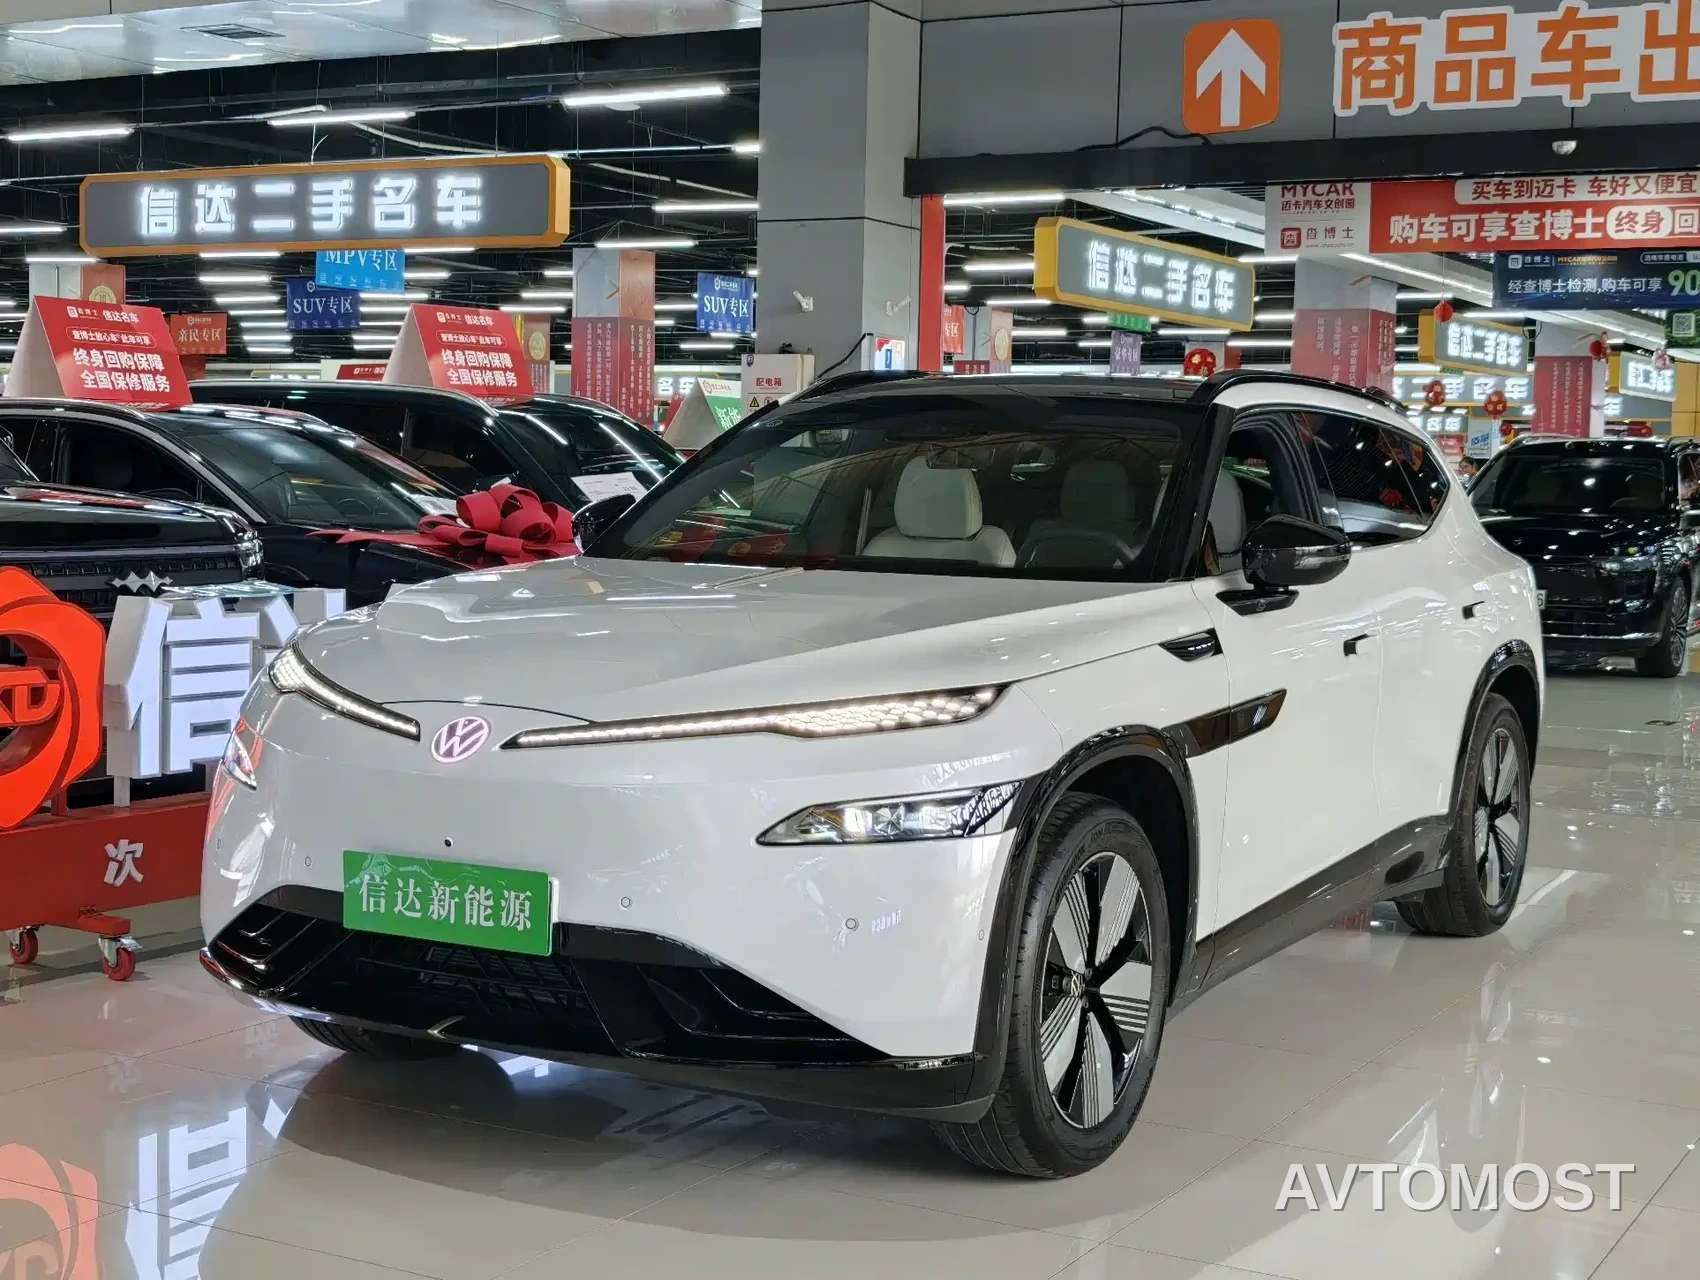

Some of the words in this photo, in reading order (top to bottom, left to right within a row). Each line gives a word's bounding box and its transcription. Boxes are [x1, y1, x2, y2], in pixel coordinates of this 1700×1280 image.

[1336, 1, 1700, 113] 商品车出
[1281, 183, 1354, 198] MYCAR
[1470, 176, 1576, 200] 买车到迈卡
[1588, 173, 1697, 197] 车好又便宜
[139, 175, 483, 237] 信达二手名车
[1281, 198, 1355, 212] 迈卡汽车文创园
[1306, 226, 1354, 240] 查博士
[325, 249, 397, 271] MPV专区
[1088, 240, 1237, 314] 信达二手名车
[1508, 276, 1663, 295] 经查博士检测,购车可享
[293, 295, 353, 314] SUV专区
[704, 295, 749, 317] SUV专区
[103, 309, 140, 324] 信达名车
[464, 314, 494, 326] 信达名车
[178, 327, 222, 342] 亲民专区
[1447, 322, 1523, 368] 信达二手名车
[72, 347, 165, 372] 终身回购保障
[441, 348, 514, 369] 终身回购保障
[80, 371, 171, 393] 全国保修服务
[447, 368, 518, 387] 全国保修服务
[756, 377, 782, 387] 配电箱
[1393, 376, 1529, 400] 二手名车
[103, 838, 144, 888] 次
[358, 874, 533, 932] 信达新能源
